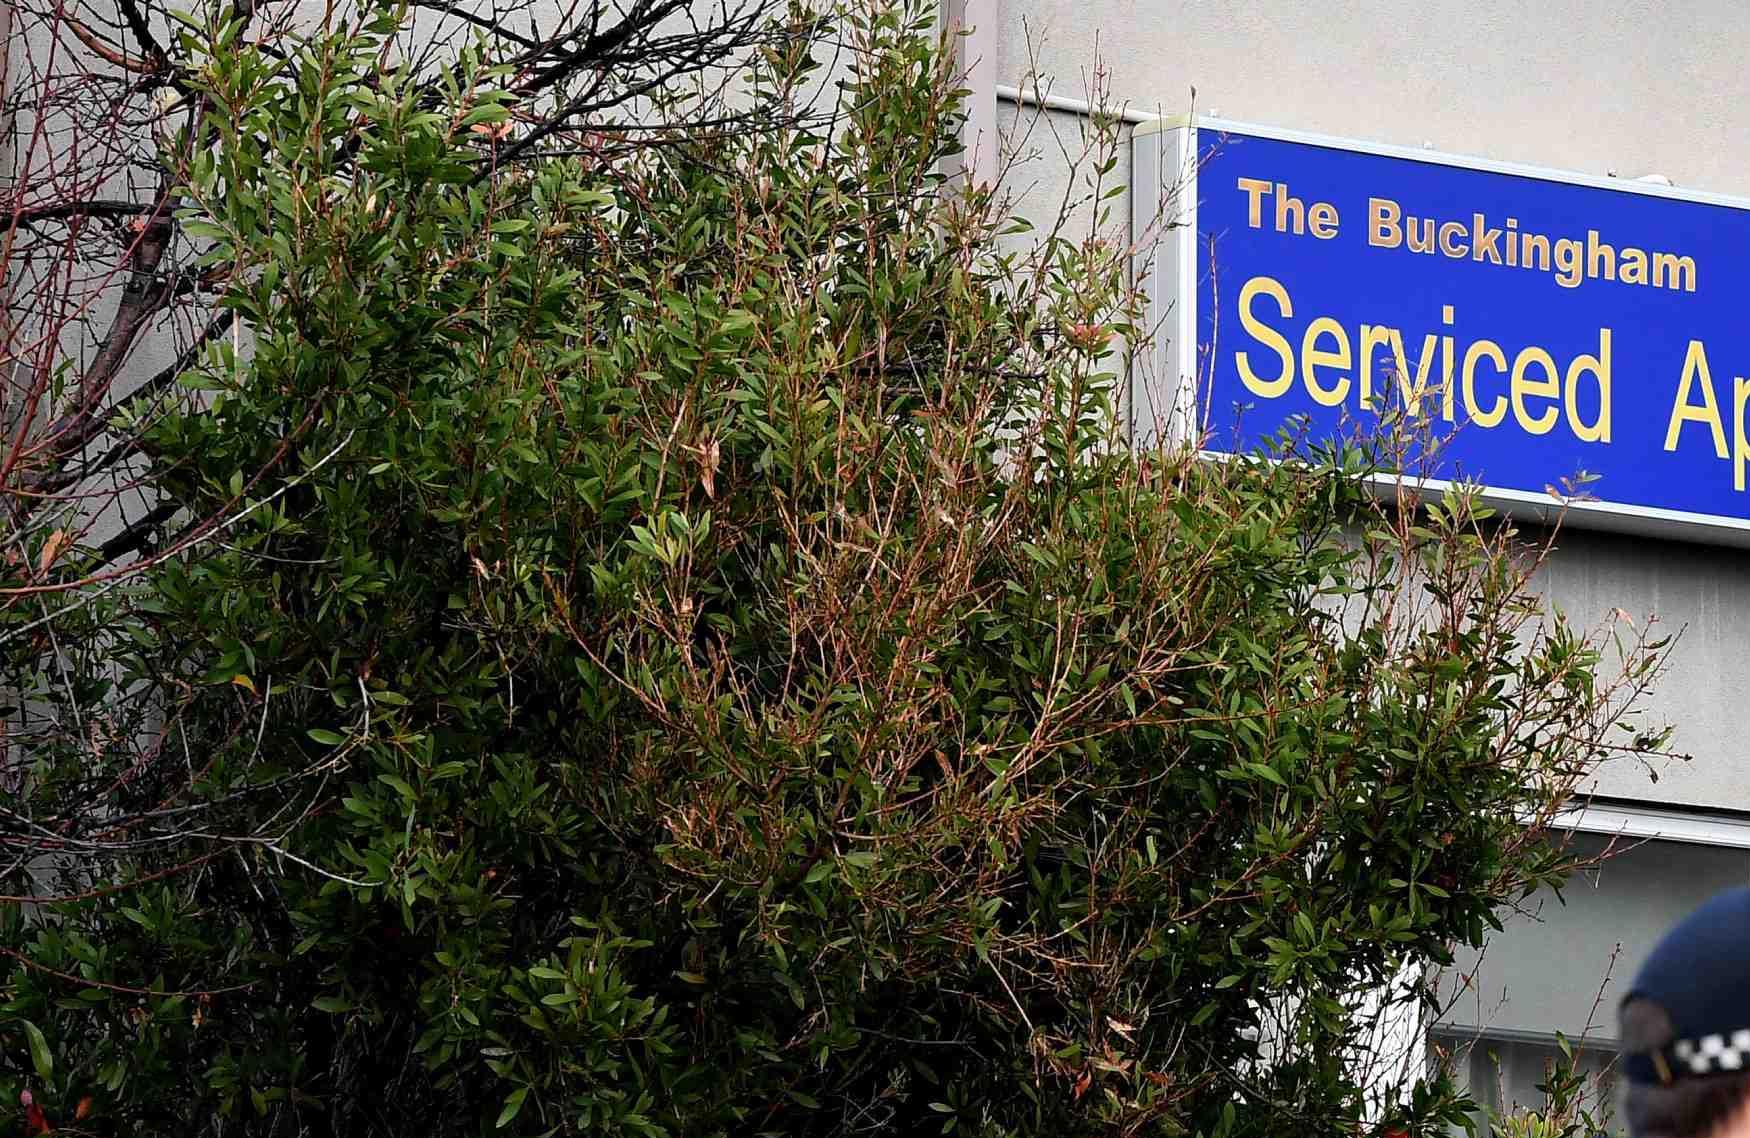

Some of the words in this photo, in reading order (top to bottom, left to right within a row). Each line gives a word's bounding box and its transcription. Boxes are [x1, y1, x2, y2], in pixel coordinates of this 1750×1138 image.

[1237, 177, 1340, 240] The
[1368, 197, 1698, 293] Buckingham
[1235, 276, 1613, 443] Serviced
